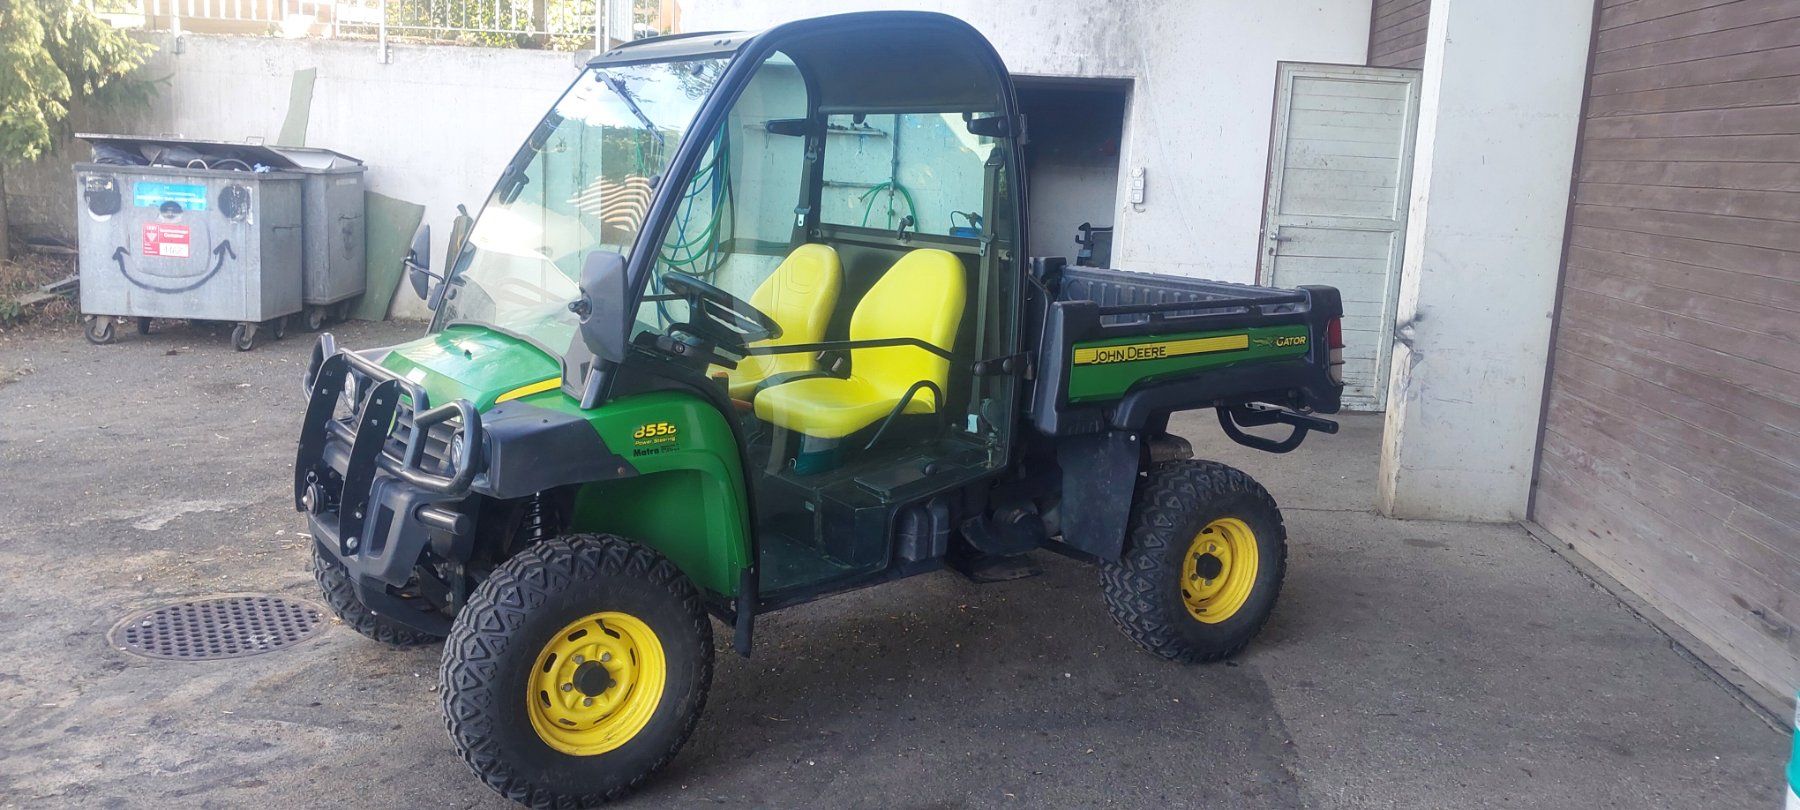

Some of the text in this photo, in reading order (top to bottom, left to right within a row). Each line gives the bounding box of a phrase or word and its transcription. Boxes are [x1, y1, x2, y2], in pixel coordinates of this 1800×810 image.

[1276, 336, 1306, 347] GATOR
[1092, 346, 1166, 362] JOHN DEERE
[633, 448, 660, 457] Matra
